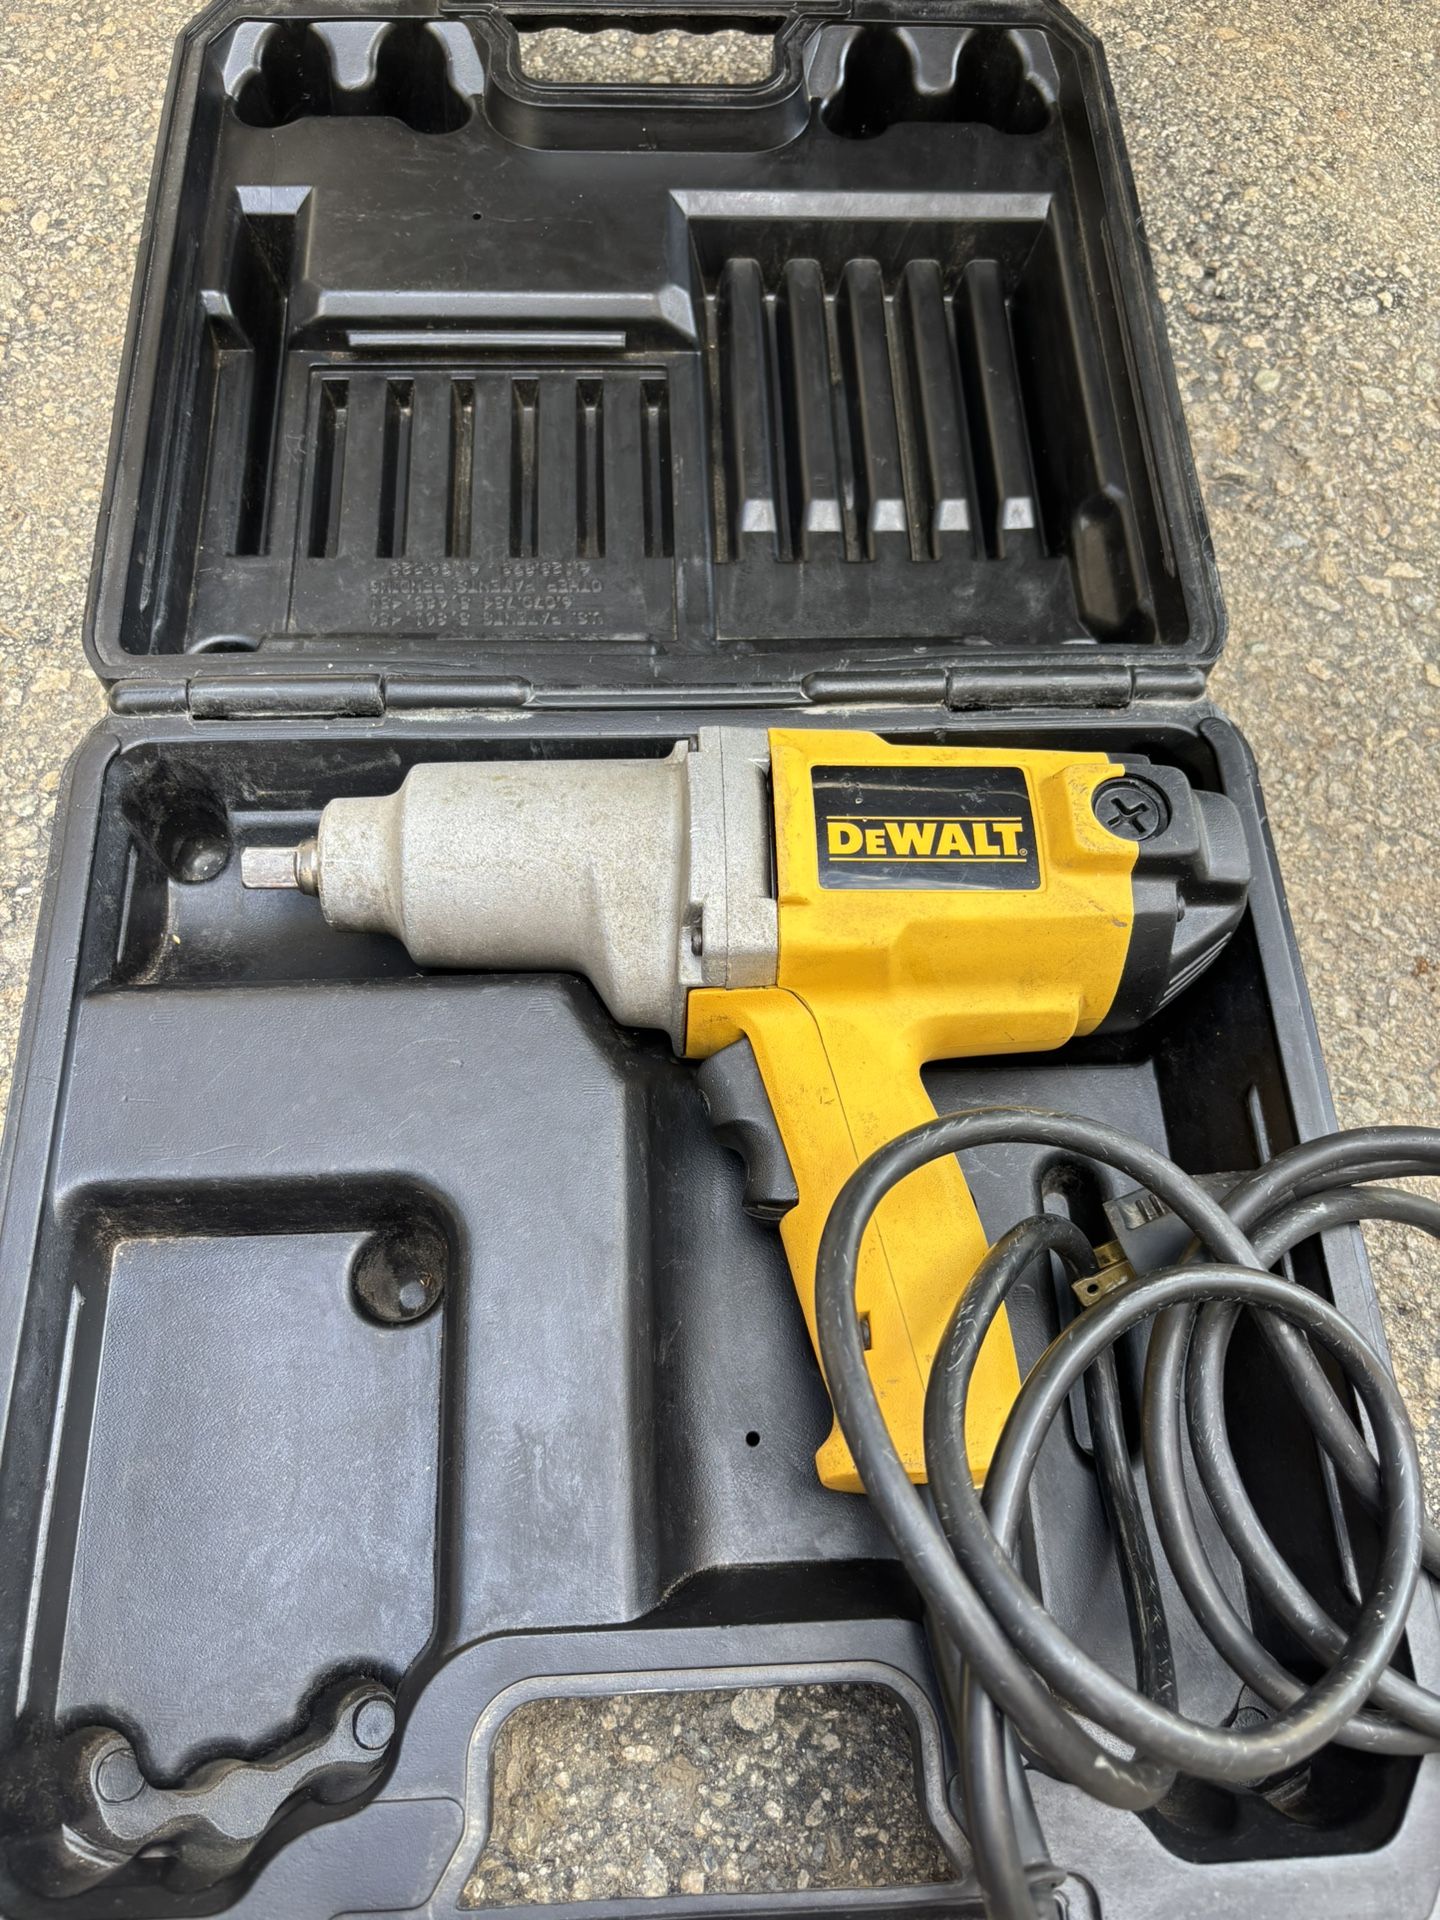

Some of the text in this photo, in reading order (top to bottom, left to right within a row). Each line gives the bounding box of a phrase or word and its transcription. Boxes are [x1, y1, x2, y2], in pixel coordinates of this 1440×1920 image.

[370, 579, 602, 594] OTHER PATENTS PENDING
